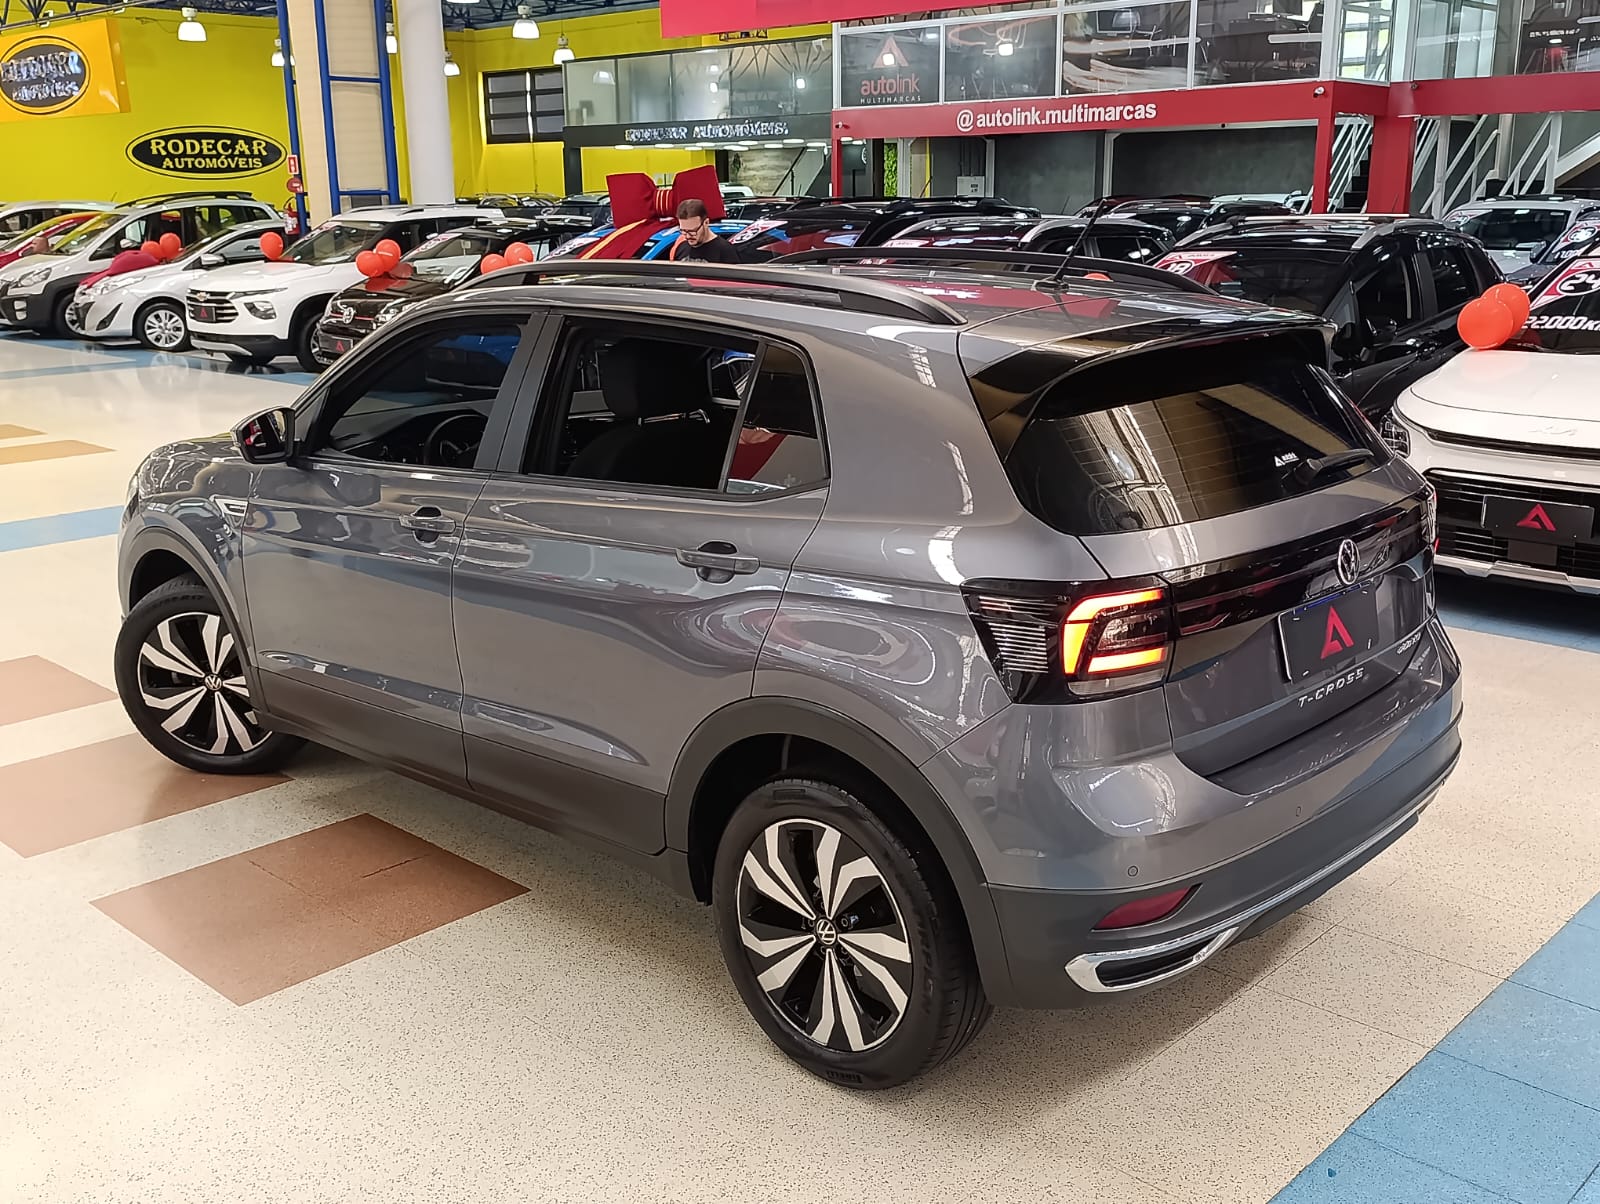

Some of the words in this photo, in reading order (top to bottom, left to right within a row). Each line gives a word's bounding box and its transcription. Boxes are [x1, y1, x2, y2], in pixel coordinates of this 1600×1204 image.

[860, 73, 920, 96] autolink
[860, 95, 921, 105] MULTIMARCAS
[150, 138, 268, 156] RODECAR
[162, 155, 263, 169] AUTOMÓVEIS
[1298, 667, 1365, 708] T-CROSS
